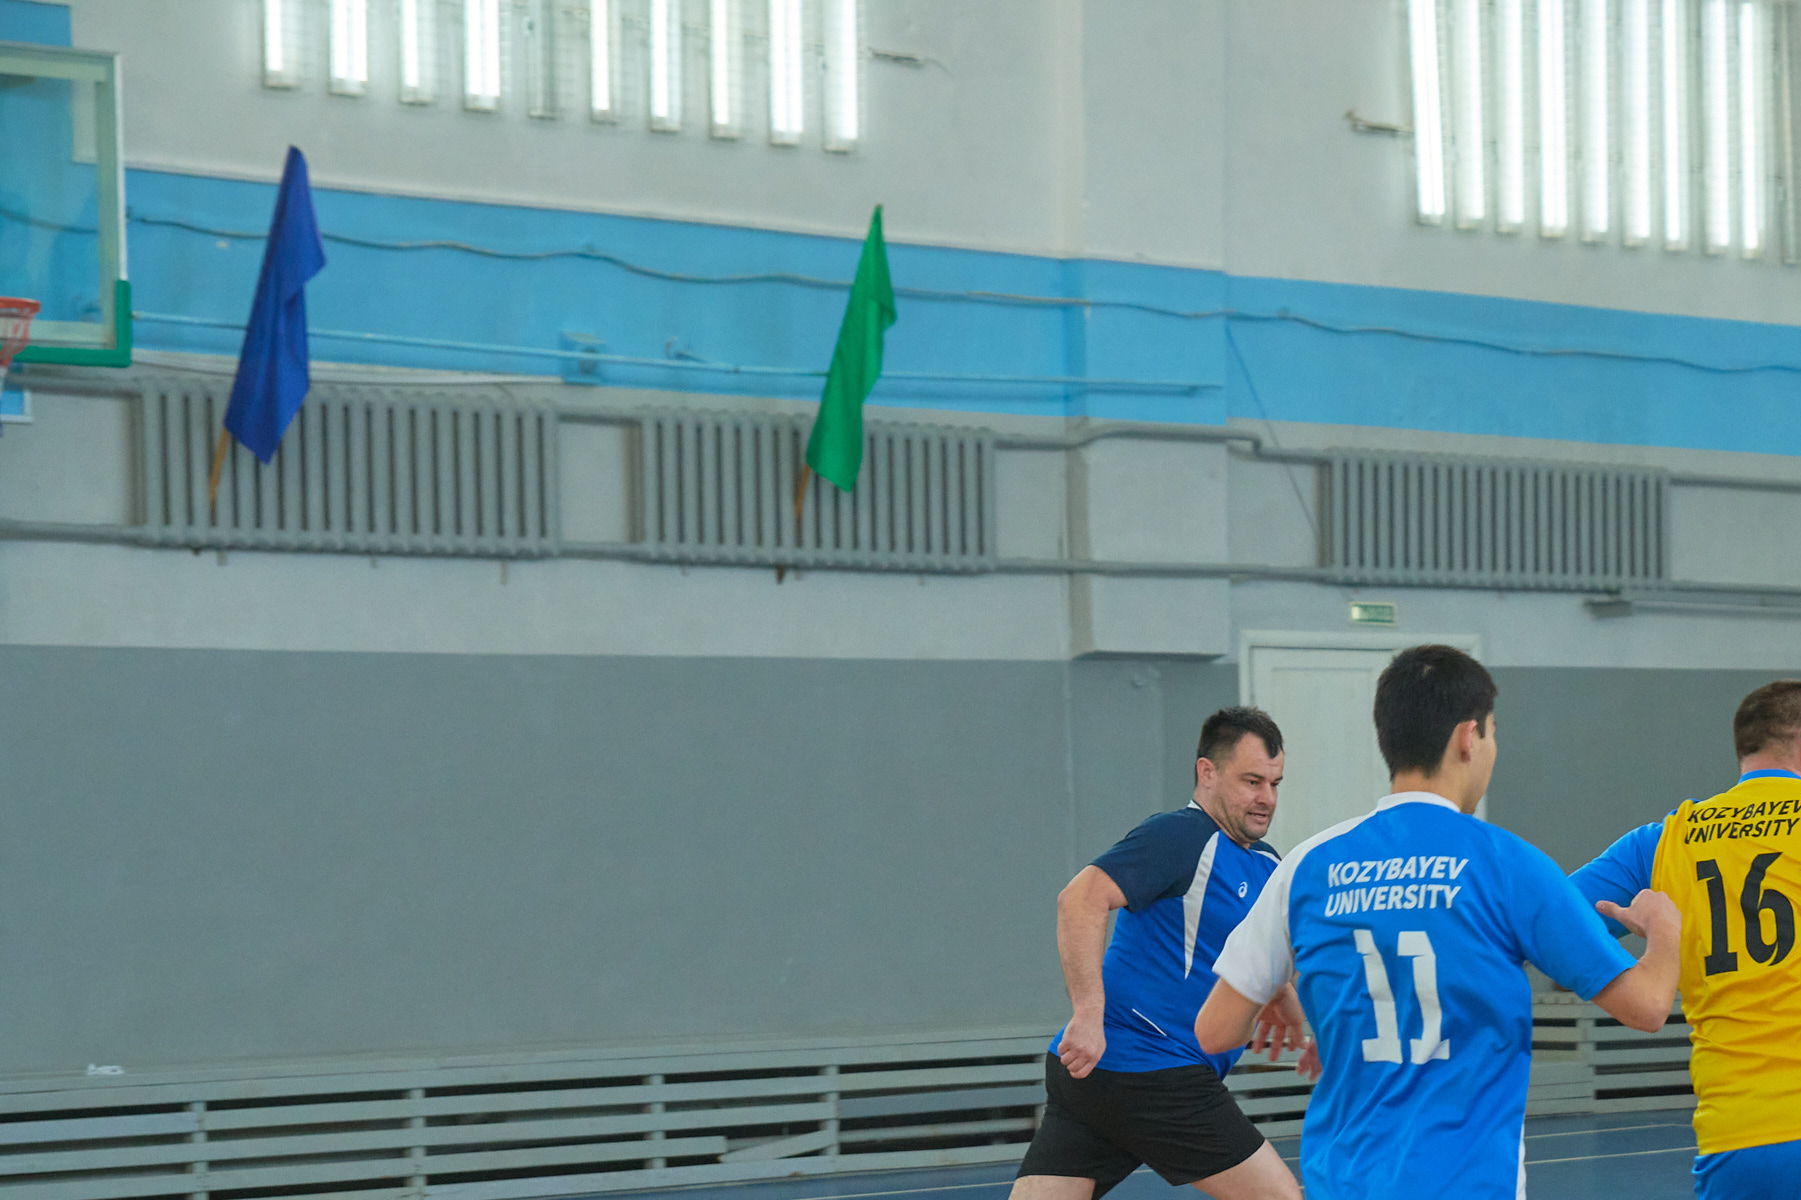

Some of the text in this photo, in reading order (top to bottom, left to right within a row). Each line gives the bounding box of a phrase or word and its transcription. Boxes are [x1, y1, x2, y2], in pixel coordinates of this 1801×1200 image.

[1684, 818, 1800, 844] UNIVERSITY
[1328, 856, 1469, 888] KOZYBAYEV
[1324, 884, 1461, 917] UNIVERSITY
[1696, 852, 1795, 976] 16
[1353, 928, 1450, 1064] 11
